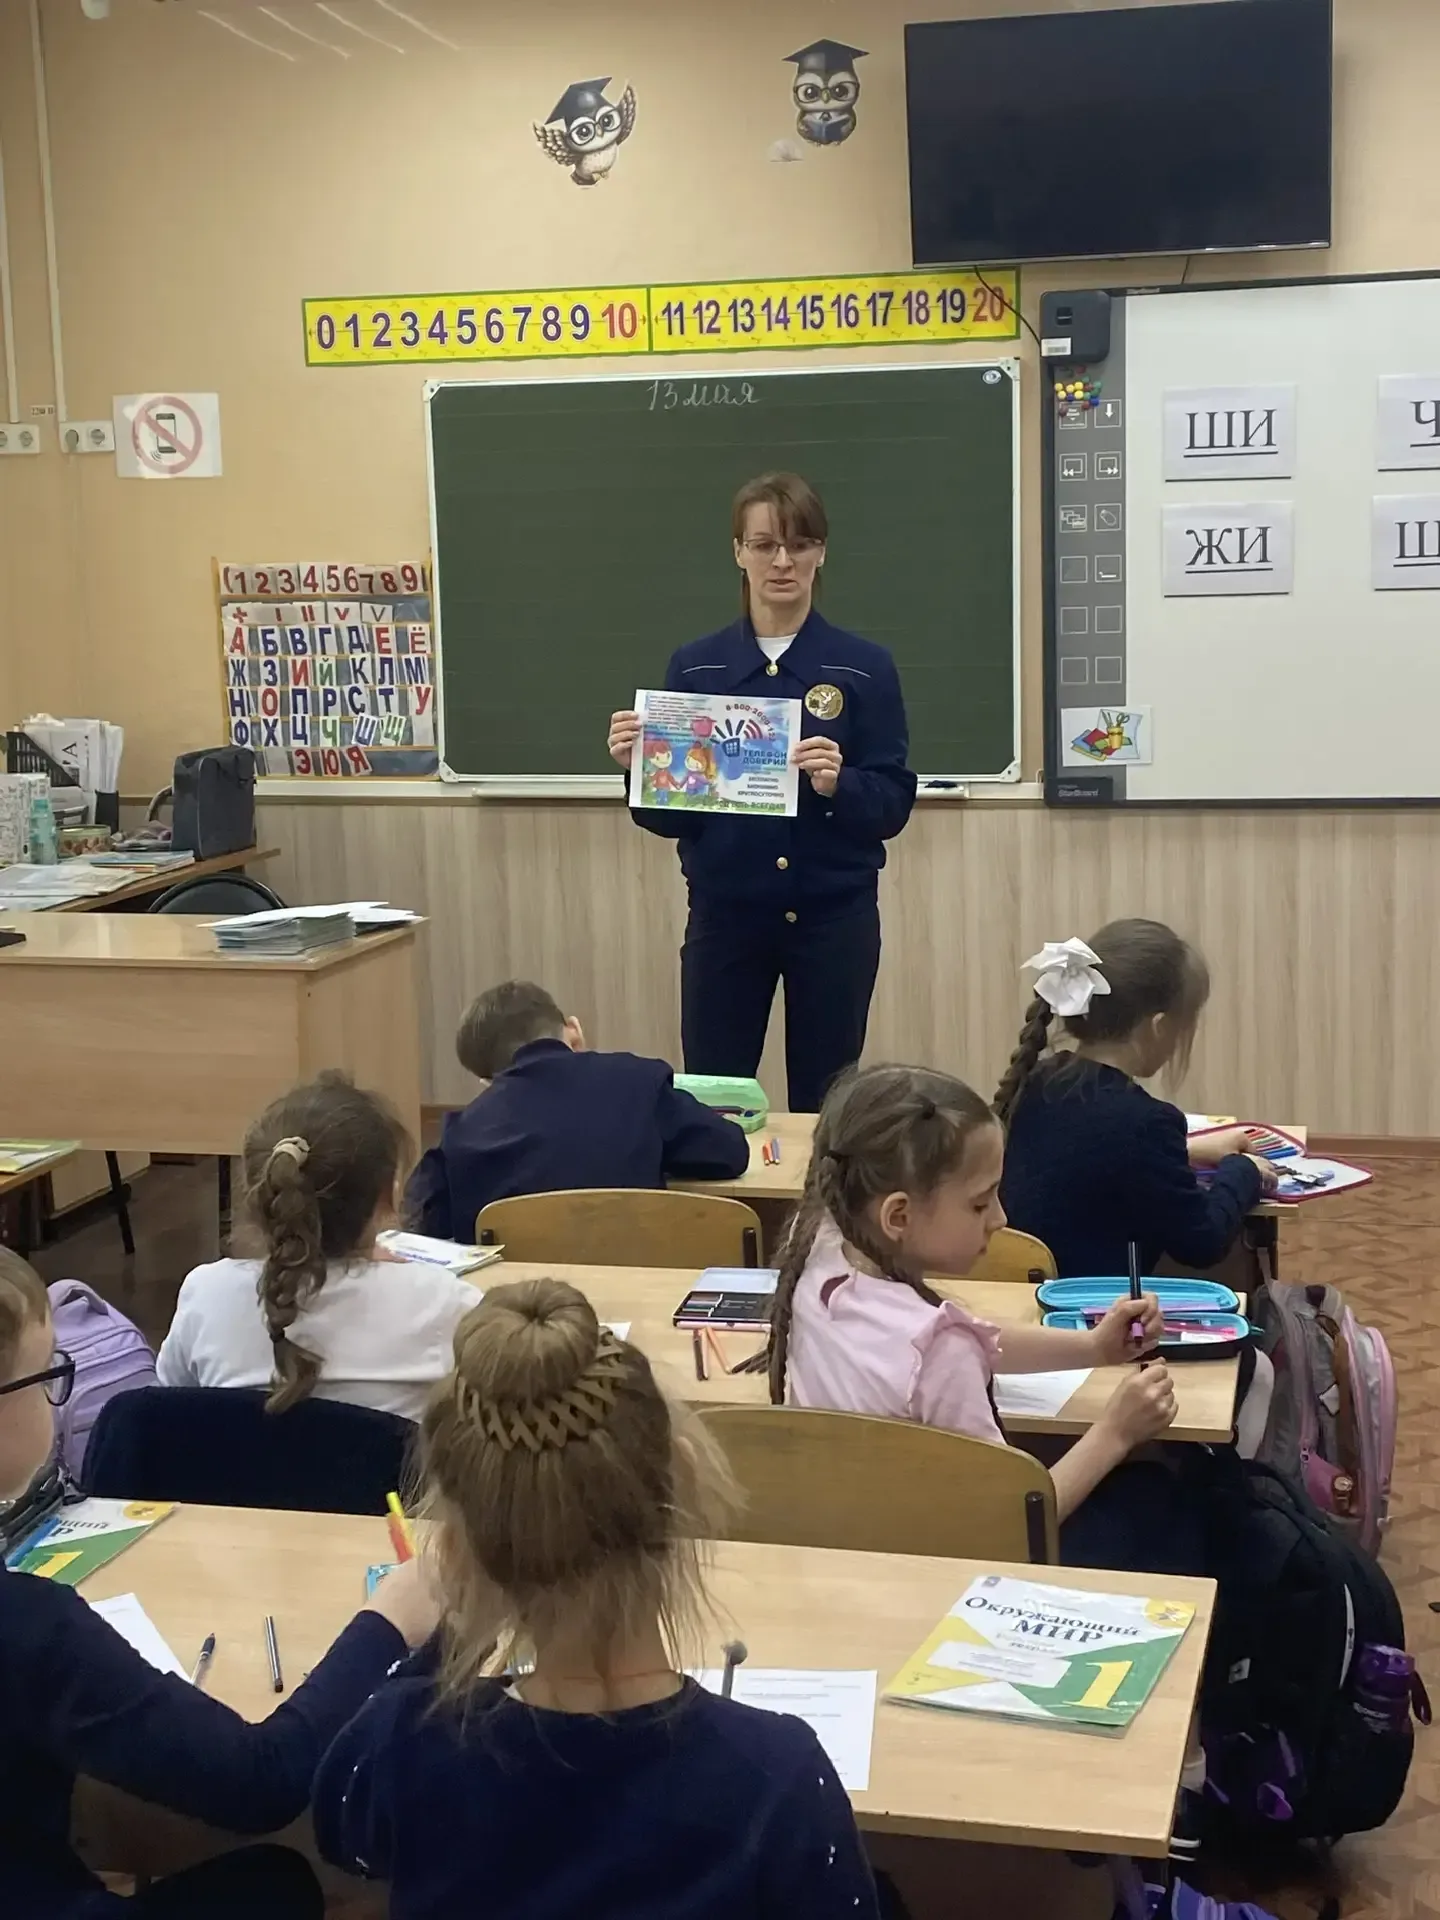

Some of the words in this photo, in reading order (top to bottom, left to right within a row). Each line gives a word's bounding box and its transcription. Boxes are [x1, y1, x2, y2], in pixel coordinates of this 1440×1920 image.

[317, 315, 334, 348] 0
[345, 314, 359, 347] 1
[373, 313, 391, 346] 2
[401, 312, 419, 346] 3
[428, 311, 448, 344] 4
[457, 309, 476, 344] 5
[486, 308, 504, 343] 6
[512, 308, 532, 341] 7
[542, 306, 561, 341] 8
[570, 305, 590, 340] 9
[602, 302, 637, 338] 10
[662, 302, 684, 335] 11
[693, 301, 720, 334] 12
[728, 299, 754, 333] 13
[761, 297, 790, 331] 14
[797, 295, 824, 329] 15
[831, 294, 859, 327] 16
[866, 292, 893, 326] 17
[903, 291, 930, 325] 18
[937, 289, 965, 323] 19
[973, 287, 1004, 322] 20
[646, 380, 678, 410] 13
[682, 382, 760, 406] мая
[1185, 409, 1277, 449] ШИ
[1185, 526, 1273, 566] ЖИ
[230, 627, 245, 653] А
[261, 628, 278, 655] Б
[289, 628, 307, 654] В
[319, 628, 331, 654] Г
[347, 626, 364, 654] Д
[375, 628, 391, 654] Е
[410, 627, 426, 653] Ё
[231, 660, 246, 686] Ж
[264, 660, 278, 686] З
[292, 660, 309, 685] И
[319, 658, 335, 686] Й
[352, 657, 369, 684] К
[379, 658, 394, 685] Л
[404, 657, 424, 685] М
[229, 689, 245, 716] Н
[262, 688, 278, 716] О
[292, 689, 308, 714] П
[323, 689, 336, 713] Р
[349, 687, 365, 714] С
[379, 689, 394, 712] Т
[412, 687, 430, 714] У
[234, 720, 248, 745] Ф
[265, 719, 279, 746] Х
[293, 717, 308, 745] Ц
[322, 719, 337, 746] Ч
[358, 717, 376, 744] Ш
[384, 717, 403, 742] Щ
[295, 750, 311, 774] Э
[322, 750, 339, 774] Ю
[348, 746, 368, 772] Я
[743, 750, 787, 758] ТЕЛЕФОН
[743, 757, 786, 766] ДОВЕРИЯ
[965, 1596, 1141, 1636] Окружающий
[1012, 1619, 1103, 1643] МИР
[1061, 1660, 1134, 1710] 1
